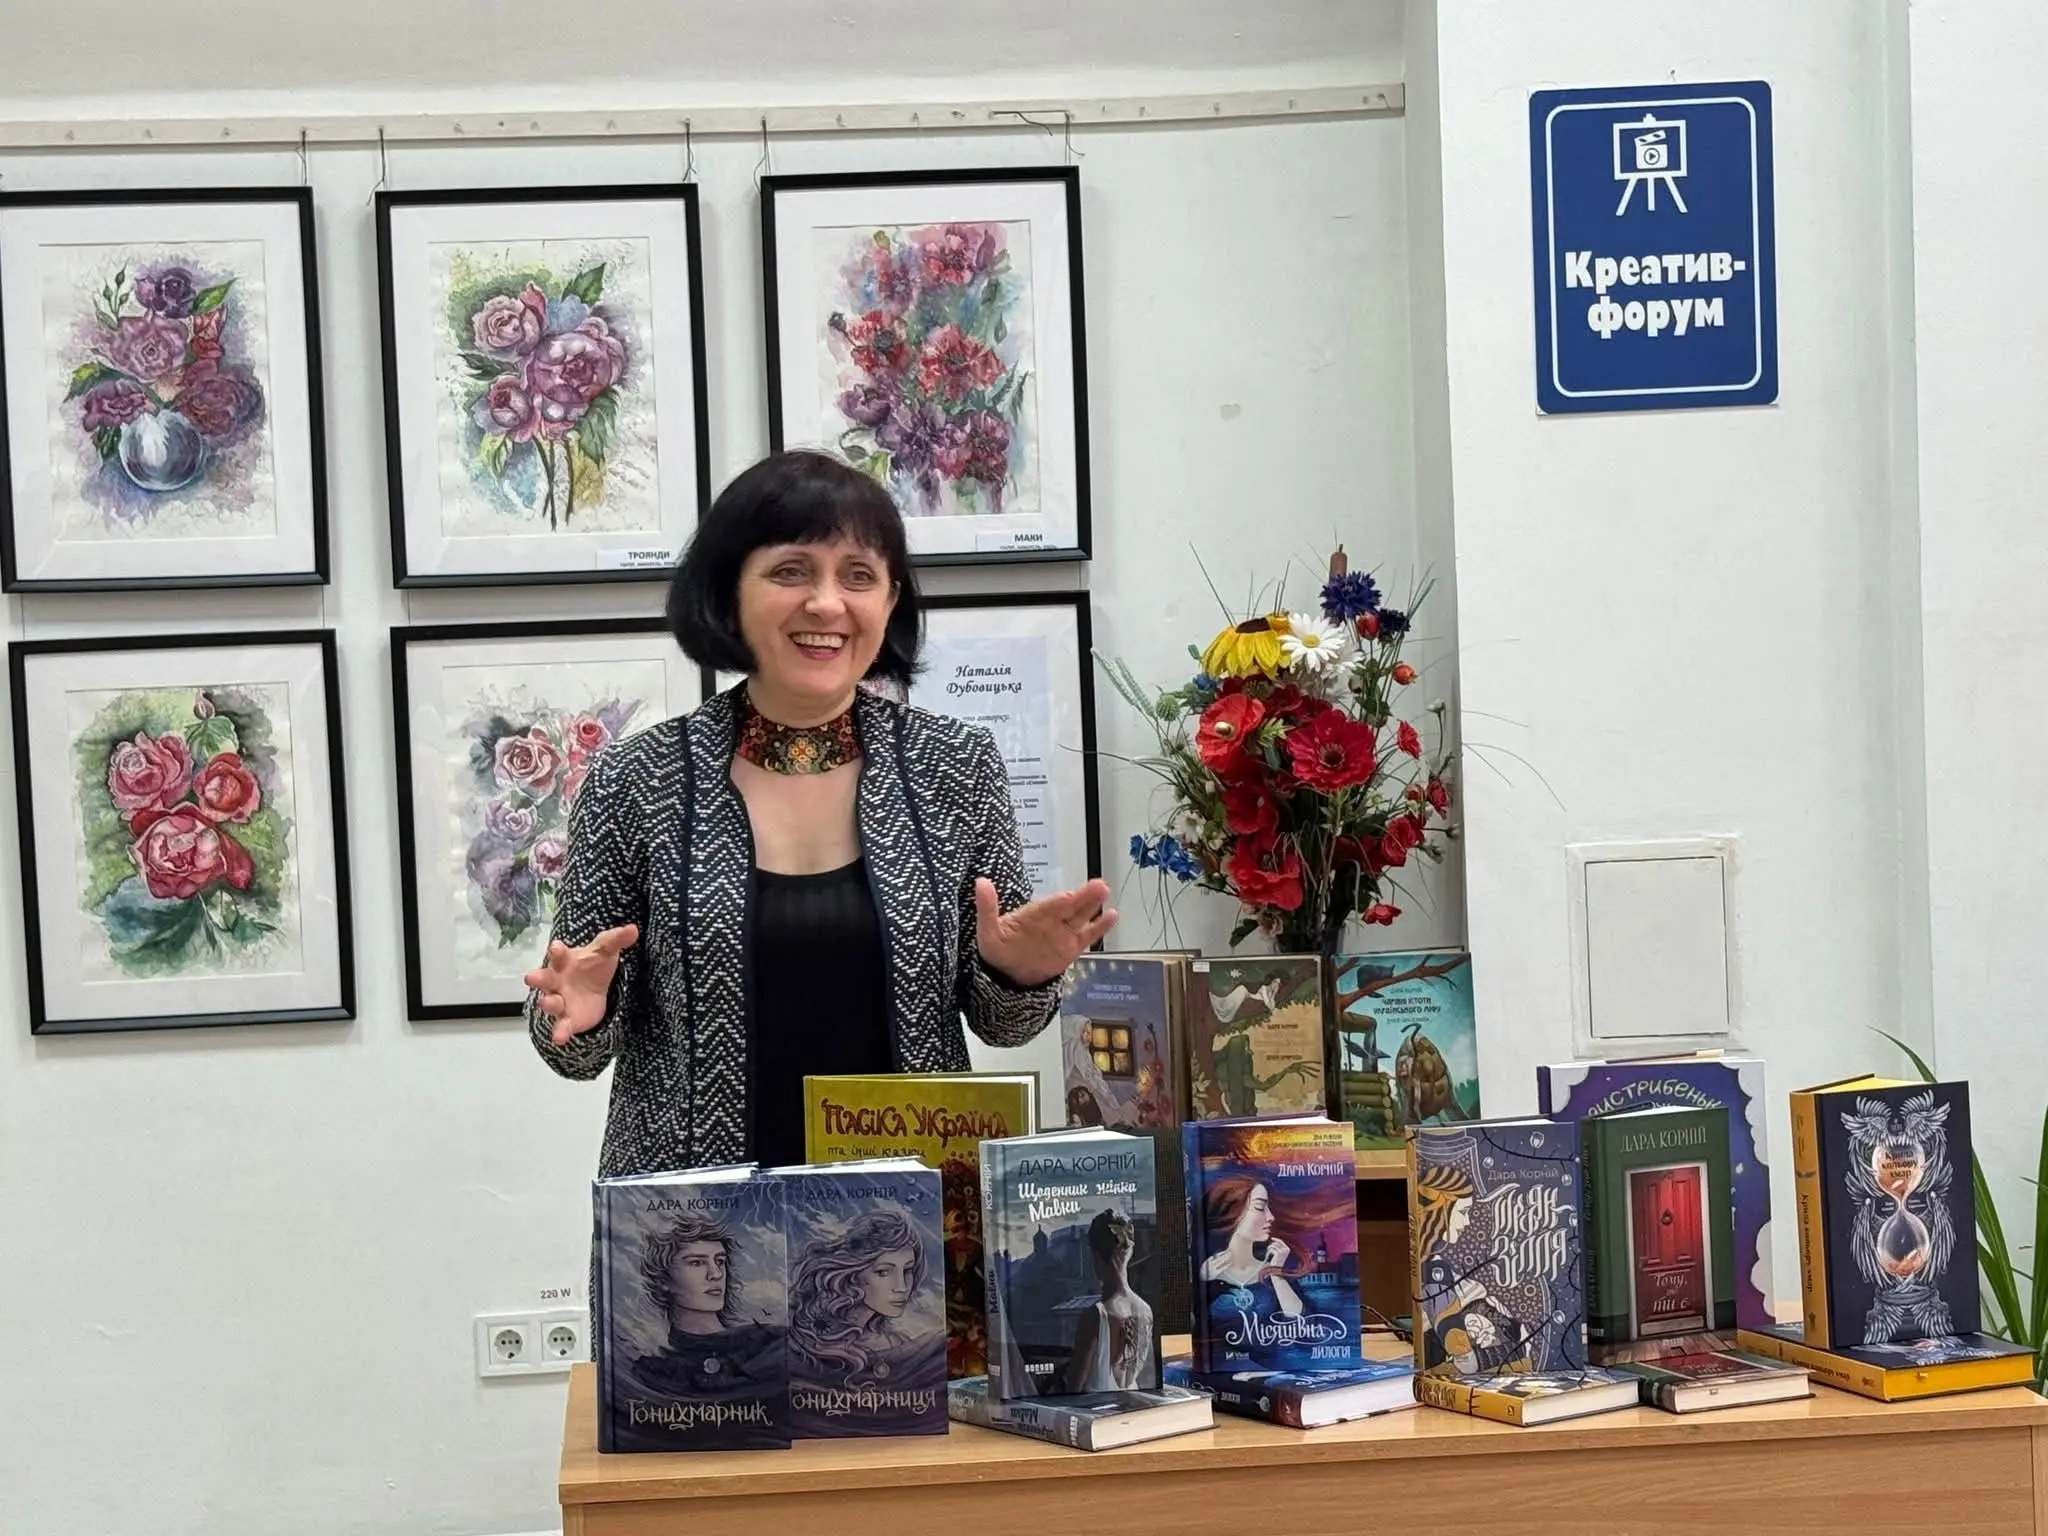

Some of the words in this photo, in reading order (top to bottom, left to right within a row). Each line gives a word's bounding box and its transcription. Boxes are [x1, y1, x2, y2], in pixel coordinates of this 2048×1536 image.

[1565, 250, 1746, 294] Креатив-
[1587, 296, 1725, 339] форум
[1014, 533, 1043, 542] МАКИ
[628, 551, 670, 561] ТРОЯНДИ
[955, 663, 1012, 678] Наталія
[946, 680, 1022, 698] Дубовицька
[1019, 1158, 1066, 1178] ДАРА
[1072, 1151, 1136, 1173] КОРНІЙ
[1018, 1182, 1089, 1202] Щоденник
[646, 1199, 682, 1212] ДАРА
[1028, 1198, 1081, 1222] Мавки
[541, 1289, 558, 1299] 220
[560, 1288, 571, 1298] W
[1225, 1310, 1348, 1347] Місяцівна
[792, 1381, 937, 1417] онихмарниця
